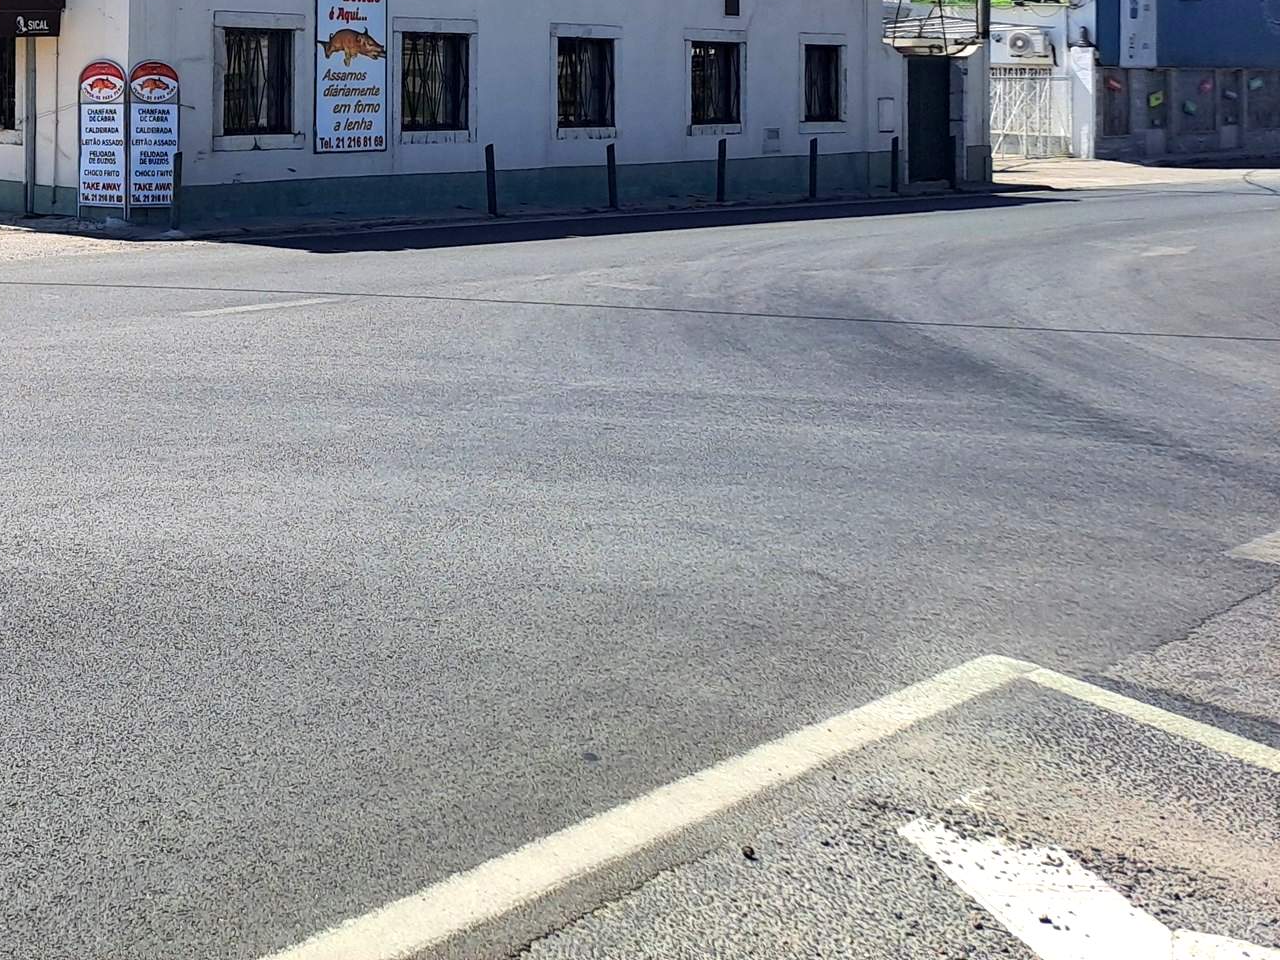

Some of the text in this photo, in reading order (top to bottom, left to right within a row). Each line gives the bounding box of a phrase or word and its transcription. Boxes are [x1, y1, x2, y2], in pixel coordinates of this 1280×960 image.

[27, 20, 49, 30] SICAL
[322, 68, 367, 81] Assamos
[333, 99, 380, 114] em forno
[333, 117, 373, 132] a lenha
[131, 137, 152, 146] LEITÃO
[319, 137, 333, 149] Tel.
[335, 137, 344, 148] 21
[347, 136, 361, 148] 216
[363, 136, 372, 147] 81
[83, 169, 103, 177] CHOCO
[82, 182, 122, 191] TAKE AWAY
[133, 182, 153, 191] TAKE
